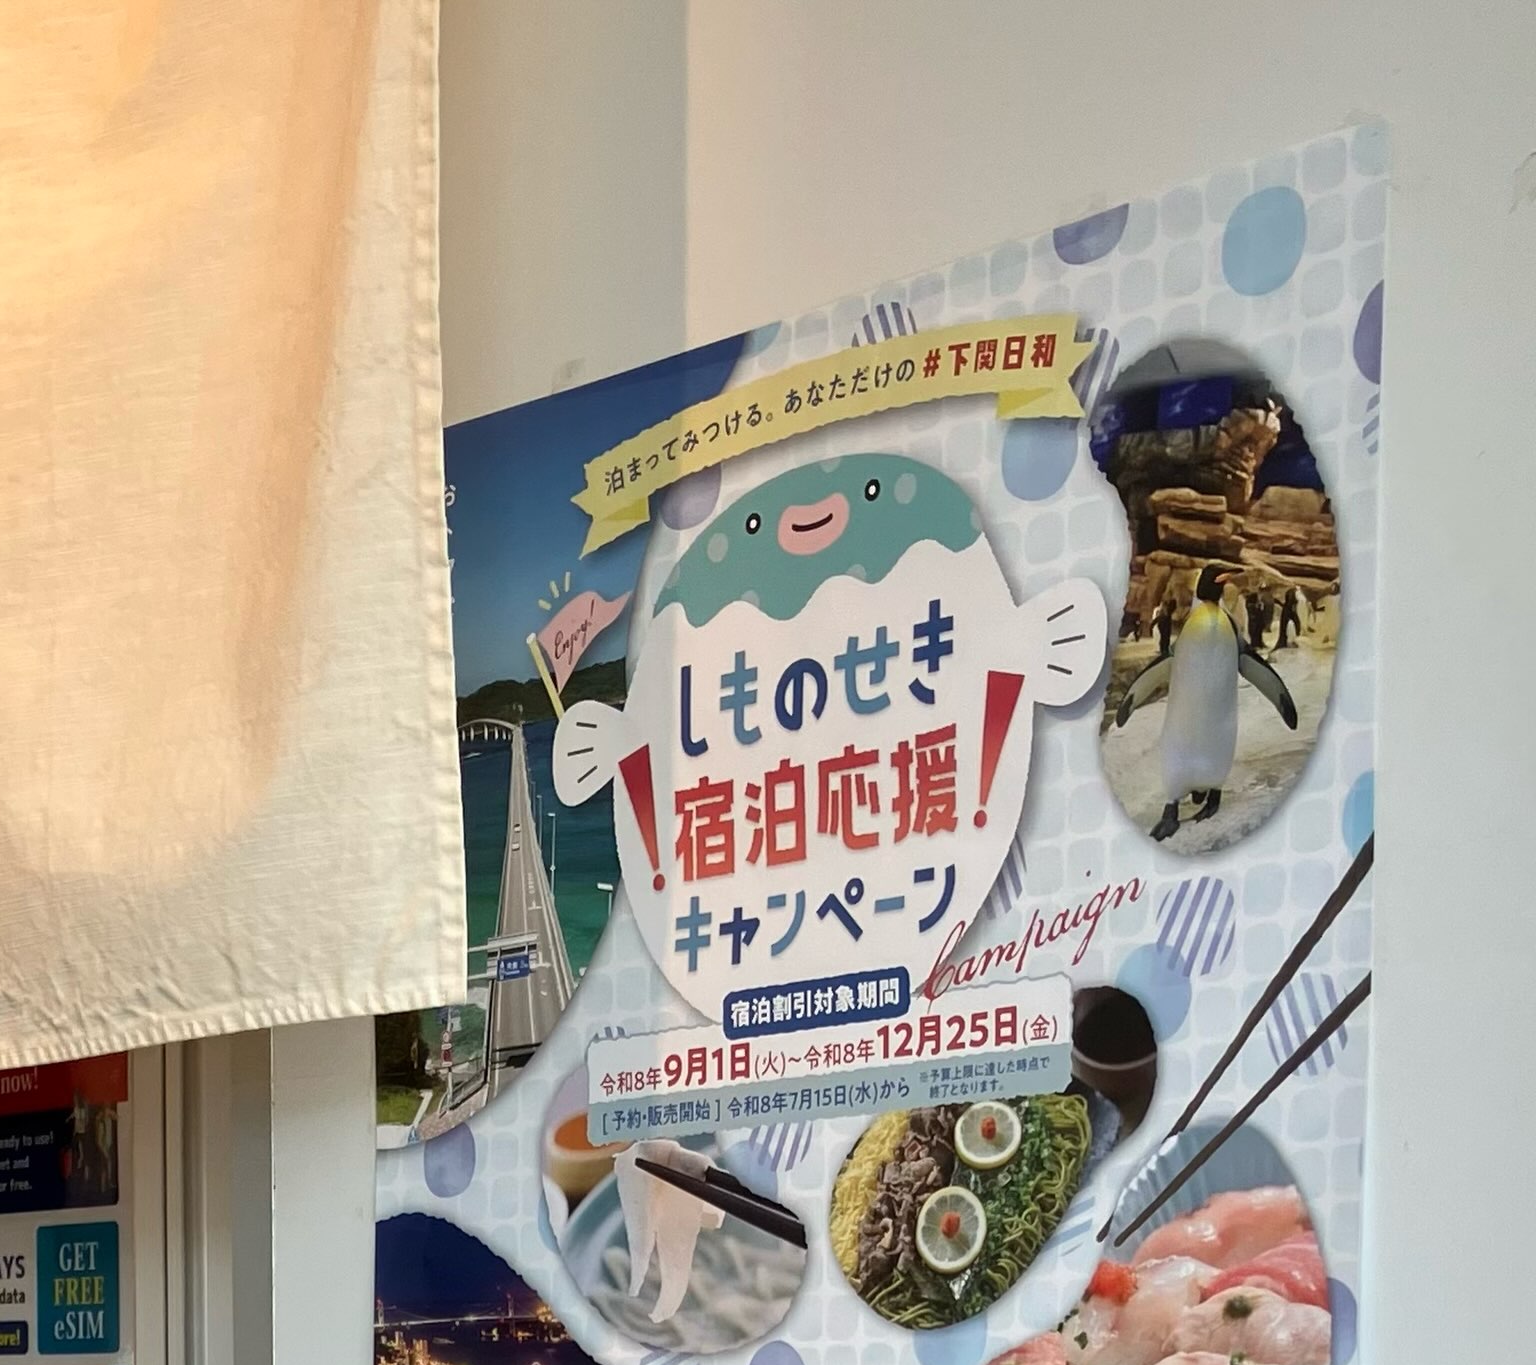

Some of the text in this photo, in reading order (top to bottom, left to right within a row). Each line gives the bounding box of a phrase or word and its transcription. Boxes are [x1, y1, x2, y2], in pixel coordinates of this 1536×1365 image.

[554, 599, 595, 665] Enjoy!
[679, 599, 955, 758] しものせき
[674, 865, 955, 973] キャンペーン
[917, 870, 1148, 1010] Campaign
[730, 977, 900, 1029] 宿泊割引対象期間
[1, 1067, 39, 1095] now!
[13, 1156, 30, 1169] and
[59, 1242, 99, 1272] GET
[0, 1290, 26, 1304] data
[54, 1276, 104, 1306] FREE
[54, 1311, 105, 1341] eSIM
